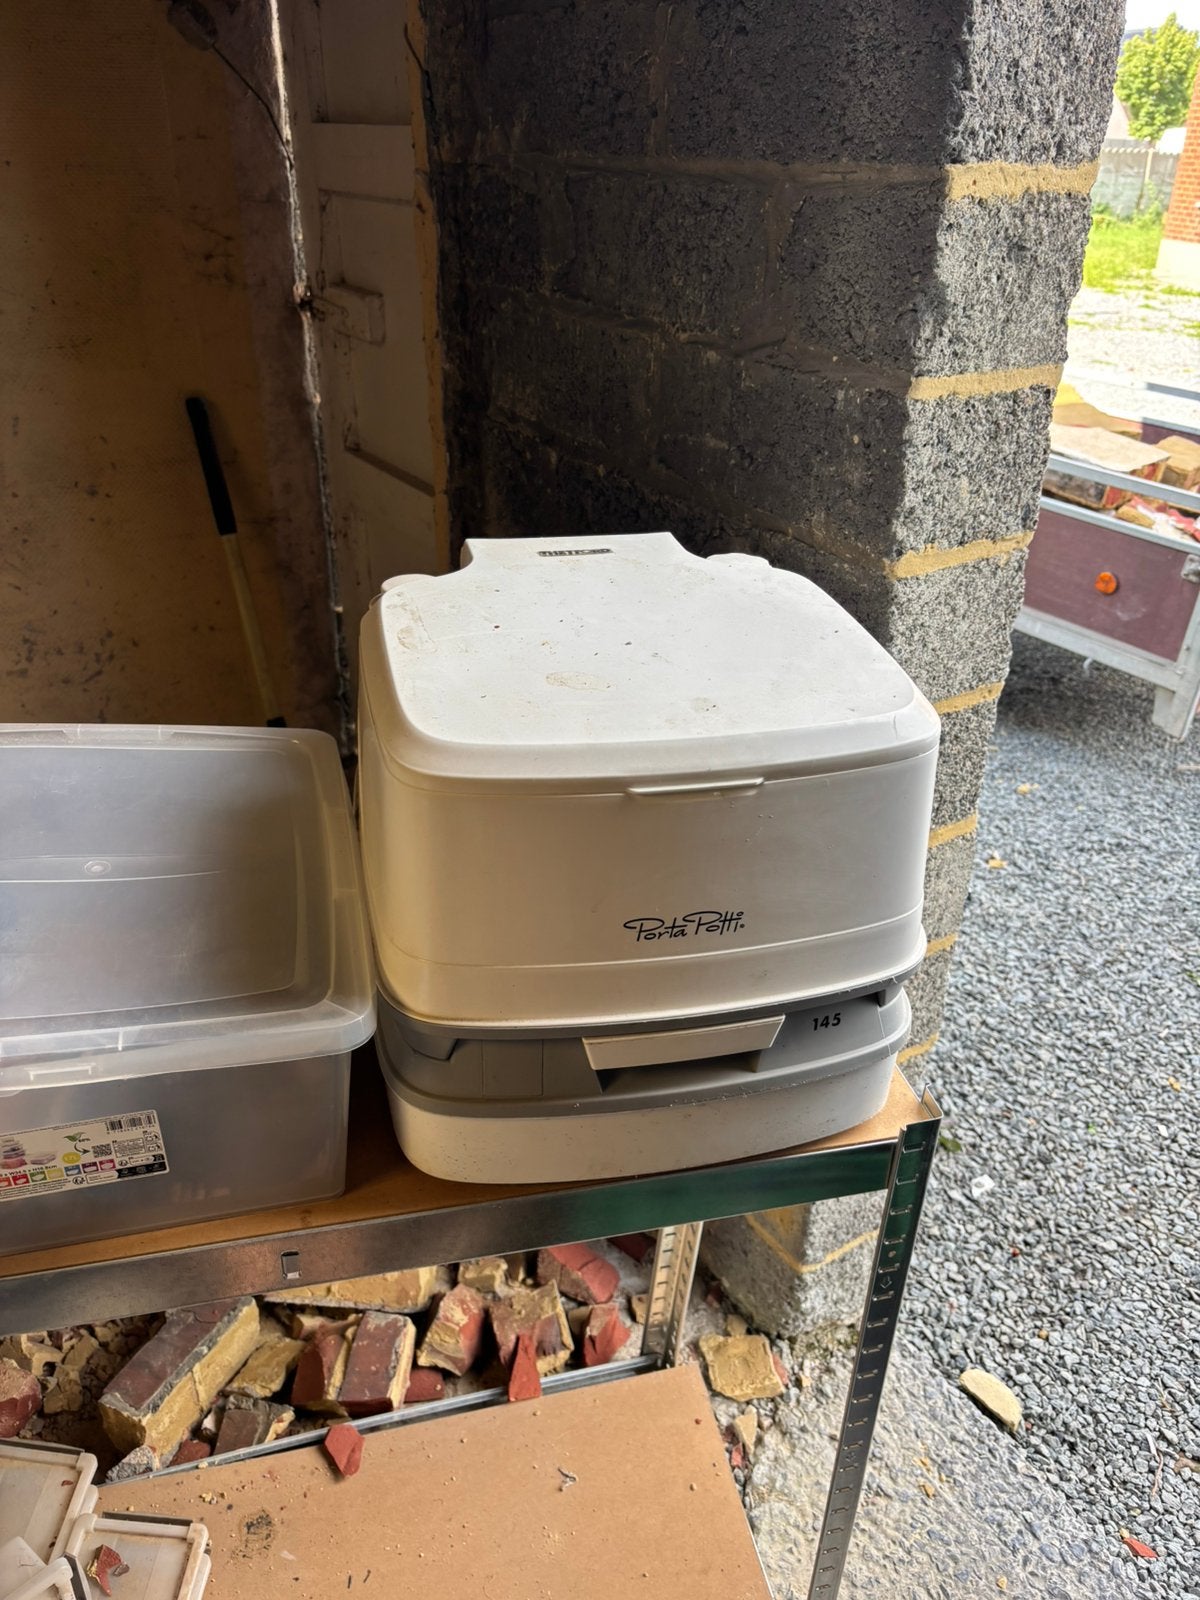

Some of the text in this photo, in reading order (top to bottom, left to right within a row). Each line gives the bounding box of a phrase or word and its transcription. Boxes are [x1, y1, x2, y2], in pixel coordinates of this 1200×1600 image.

[623, 911, 744, 942] Porta Potti
[812, 1012, 842, 1031] 145
